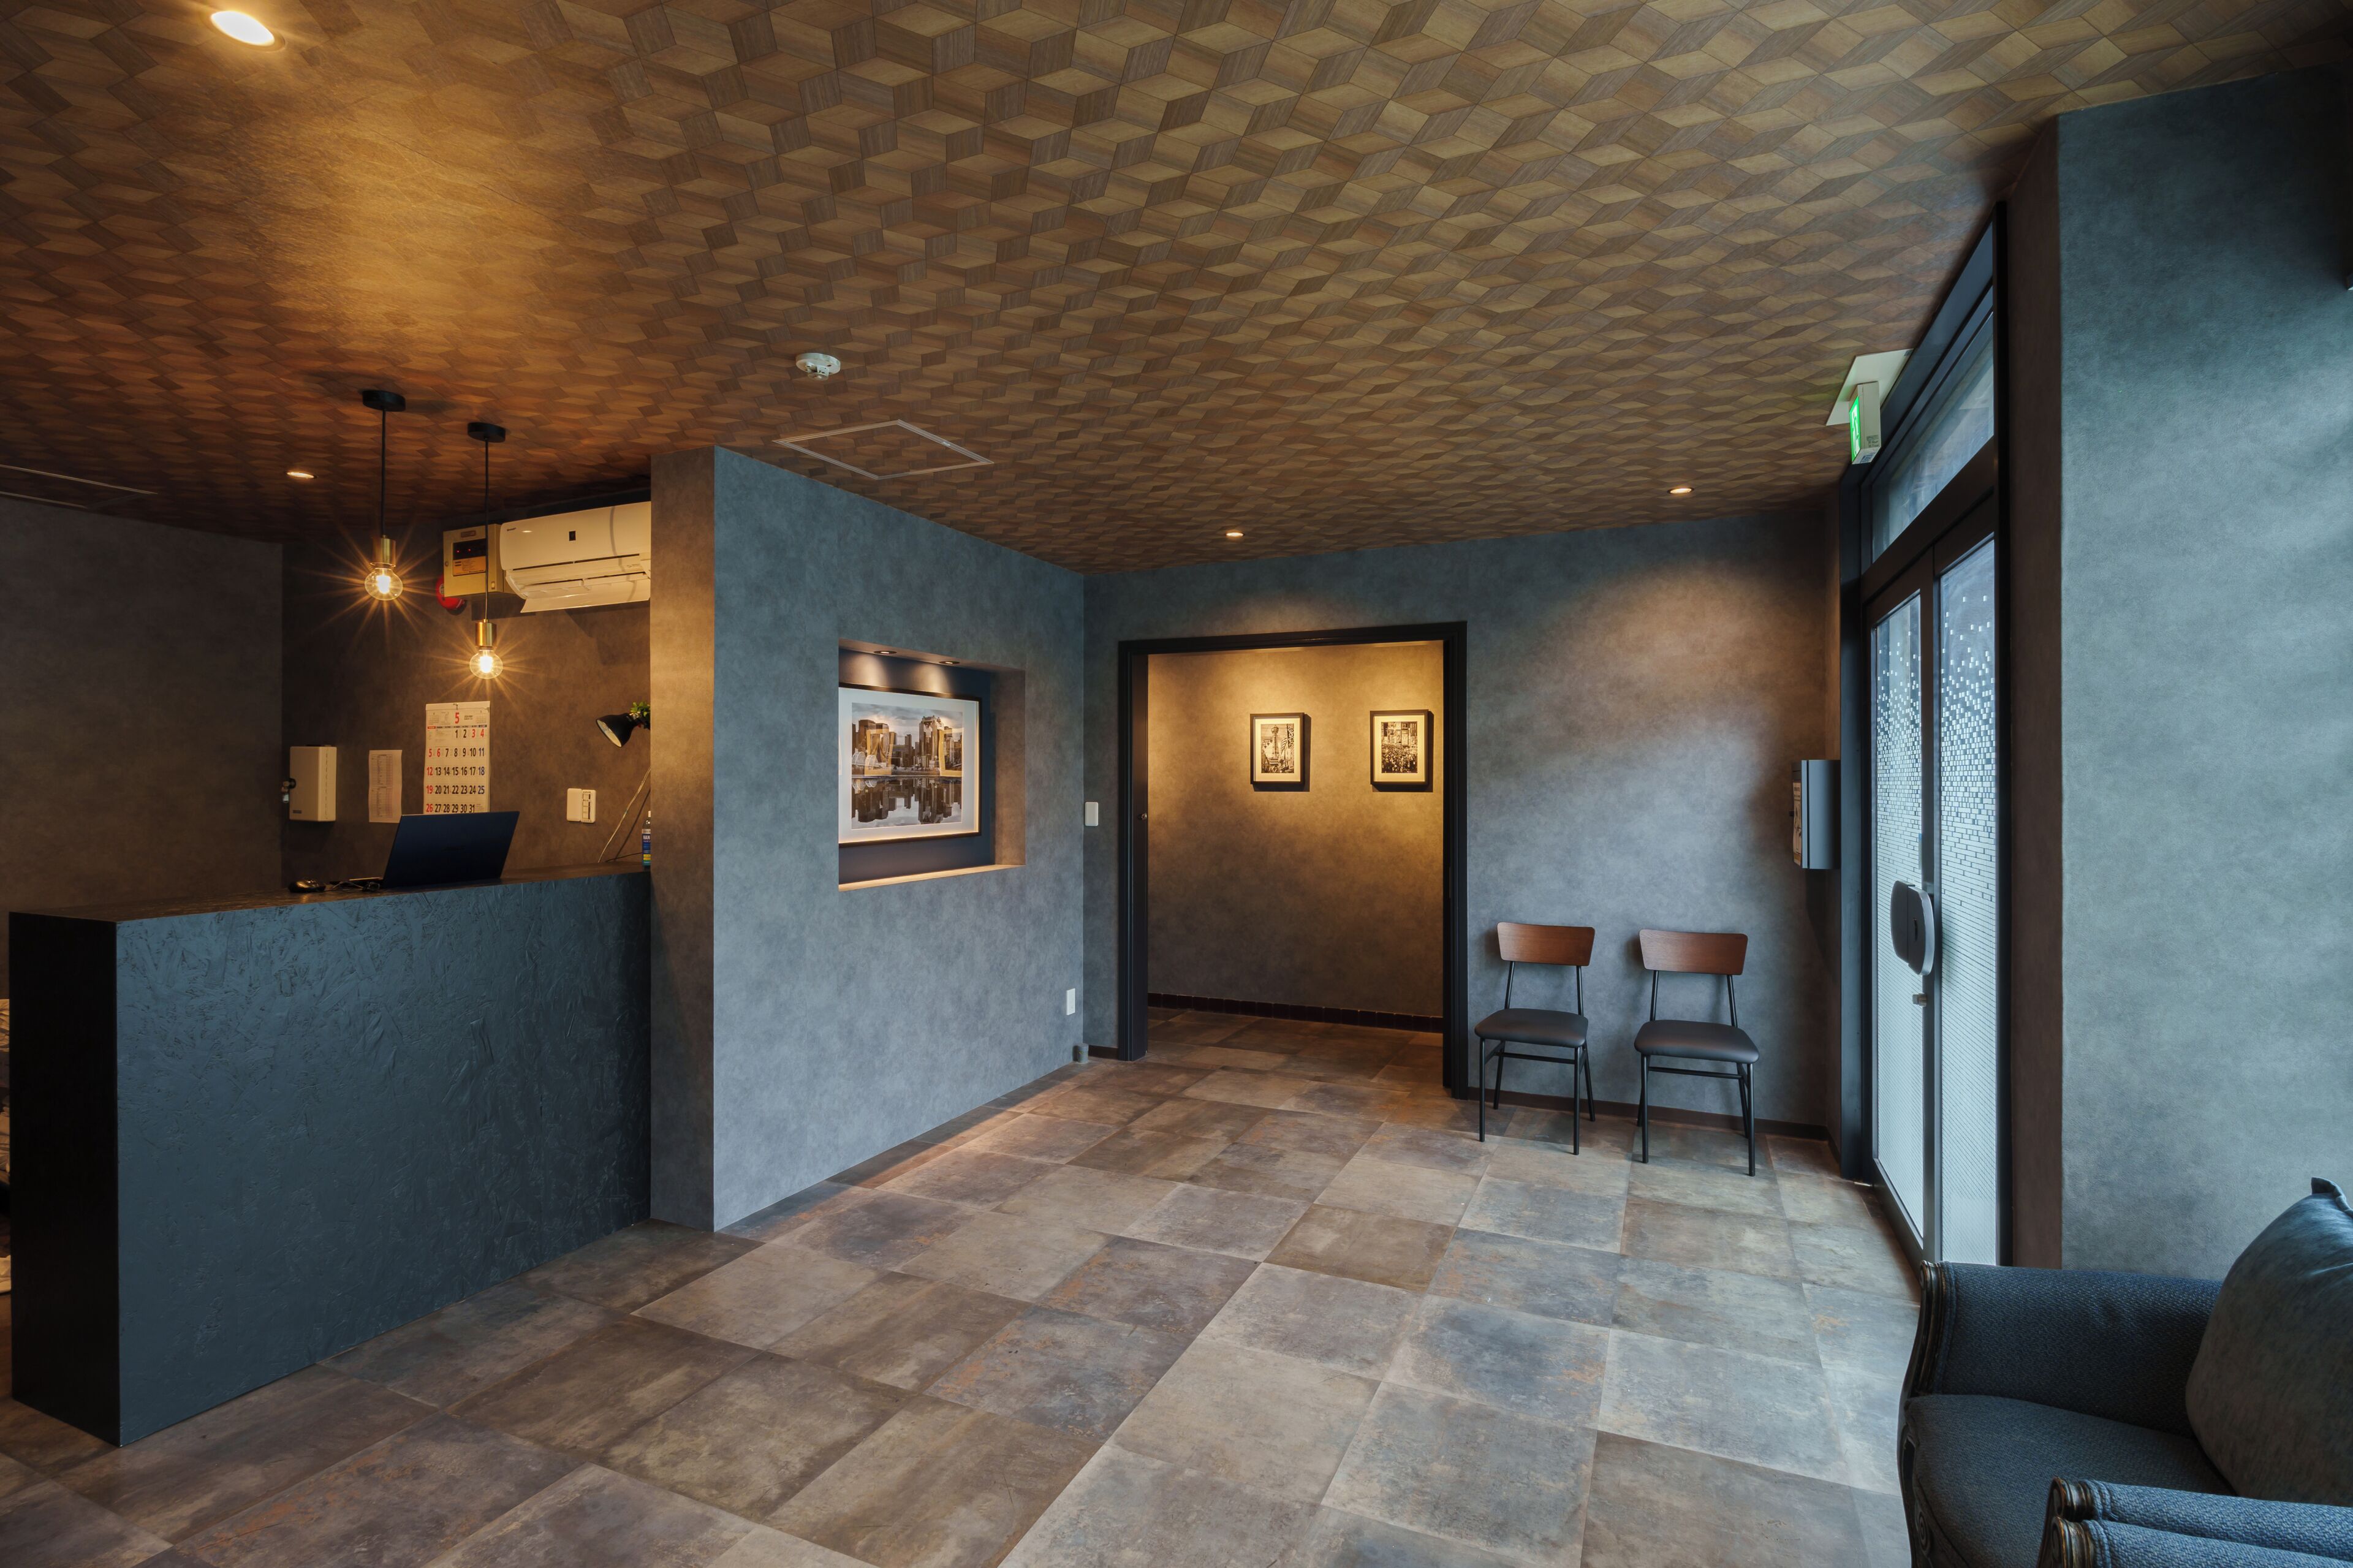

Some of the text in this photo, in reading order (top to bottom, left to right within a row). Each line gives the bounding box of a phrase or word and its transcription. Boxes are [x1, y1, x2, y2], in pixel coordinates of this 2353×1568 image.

[455, 712, 459, 724] 5
[455, 730, 458, 738] 1
[463, 729, 466, 738] 2
[472, 729, 475, 738] 3
[481, 728, 484, 737] 4
[429, 747, 484, 757] 5 6 7 8 9 10 11
[427, 767, 484, 775] 12 13 14 15 16 17 18
[426, 785, 484, 794] 19 20 21 22 23 24 25
[426, 804, 475, 813] 26 27 28 29 30 31
